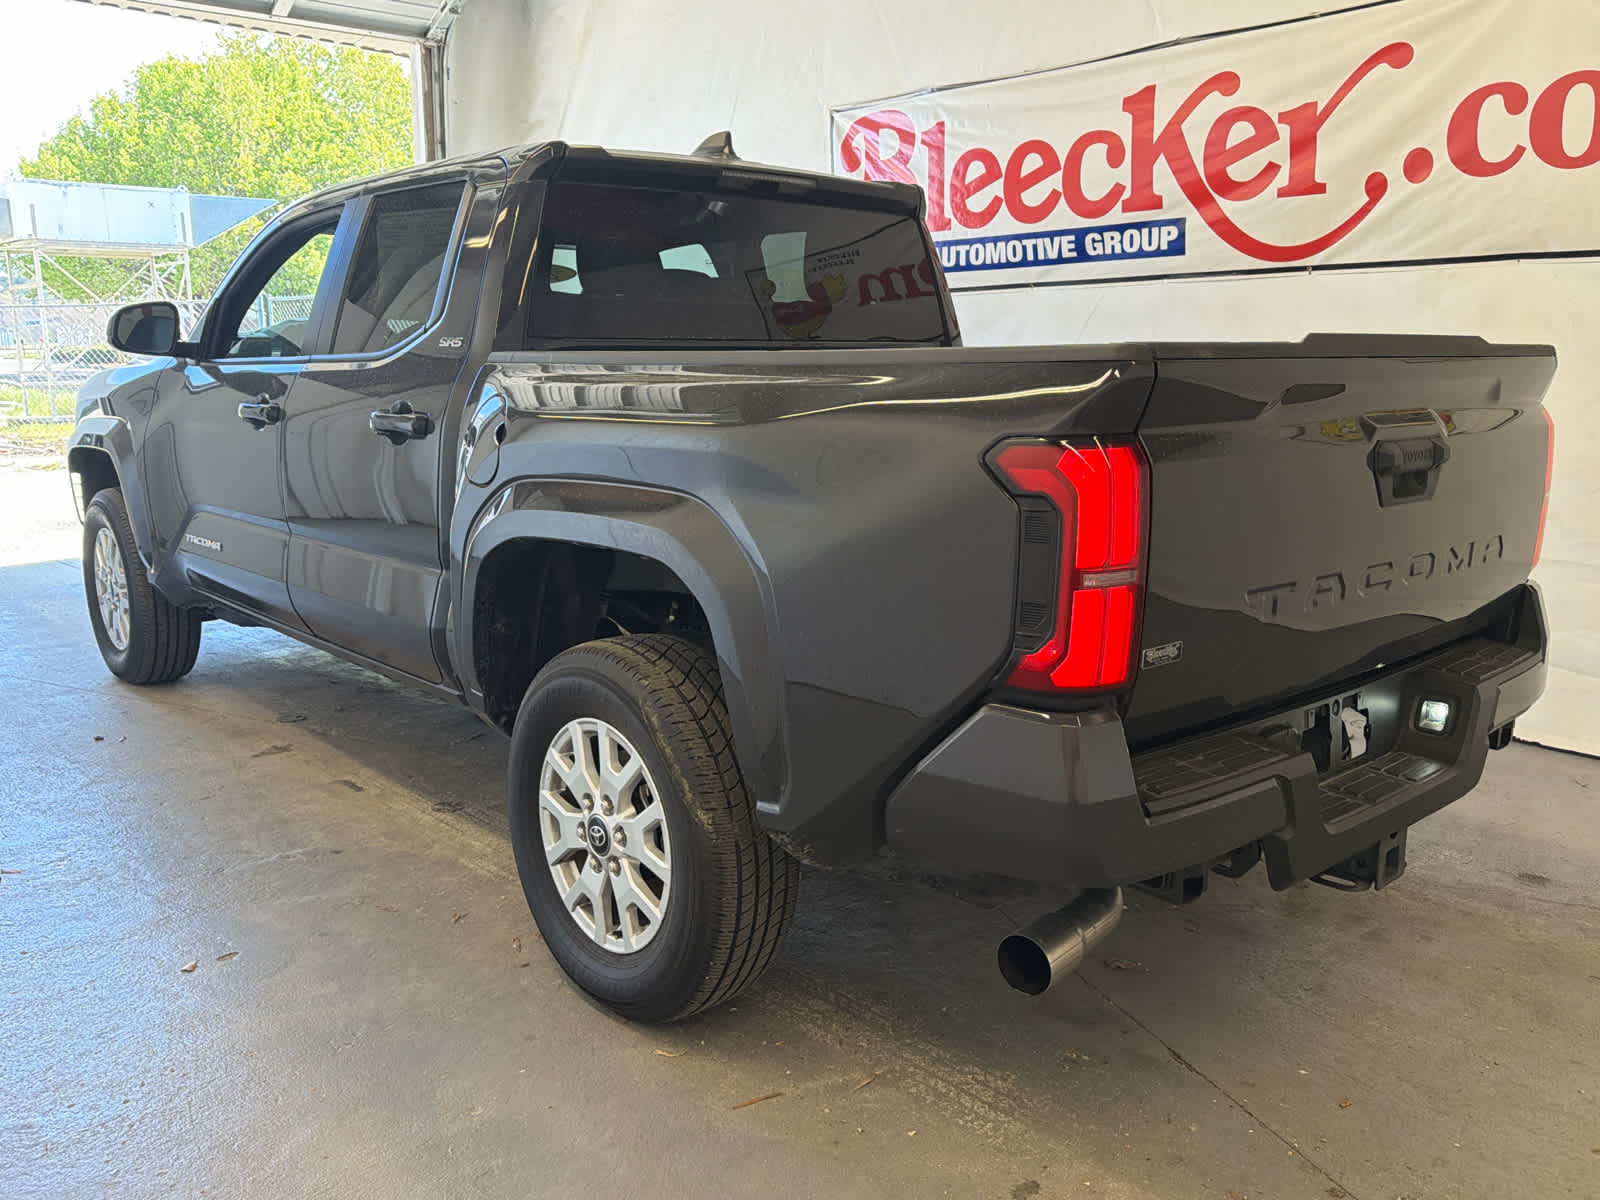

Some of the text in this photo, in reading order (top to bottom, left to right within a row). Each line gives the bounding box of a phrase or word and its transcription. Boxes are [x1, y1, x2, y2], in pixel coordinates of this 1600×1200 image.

[1084, 225, 1180, 257] GROUP
[184, 533, 223, 552] TACOMA
[1245, 534, 1504, 618] TACOMA
